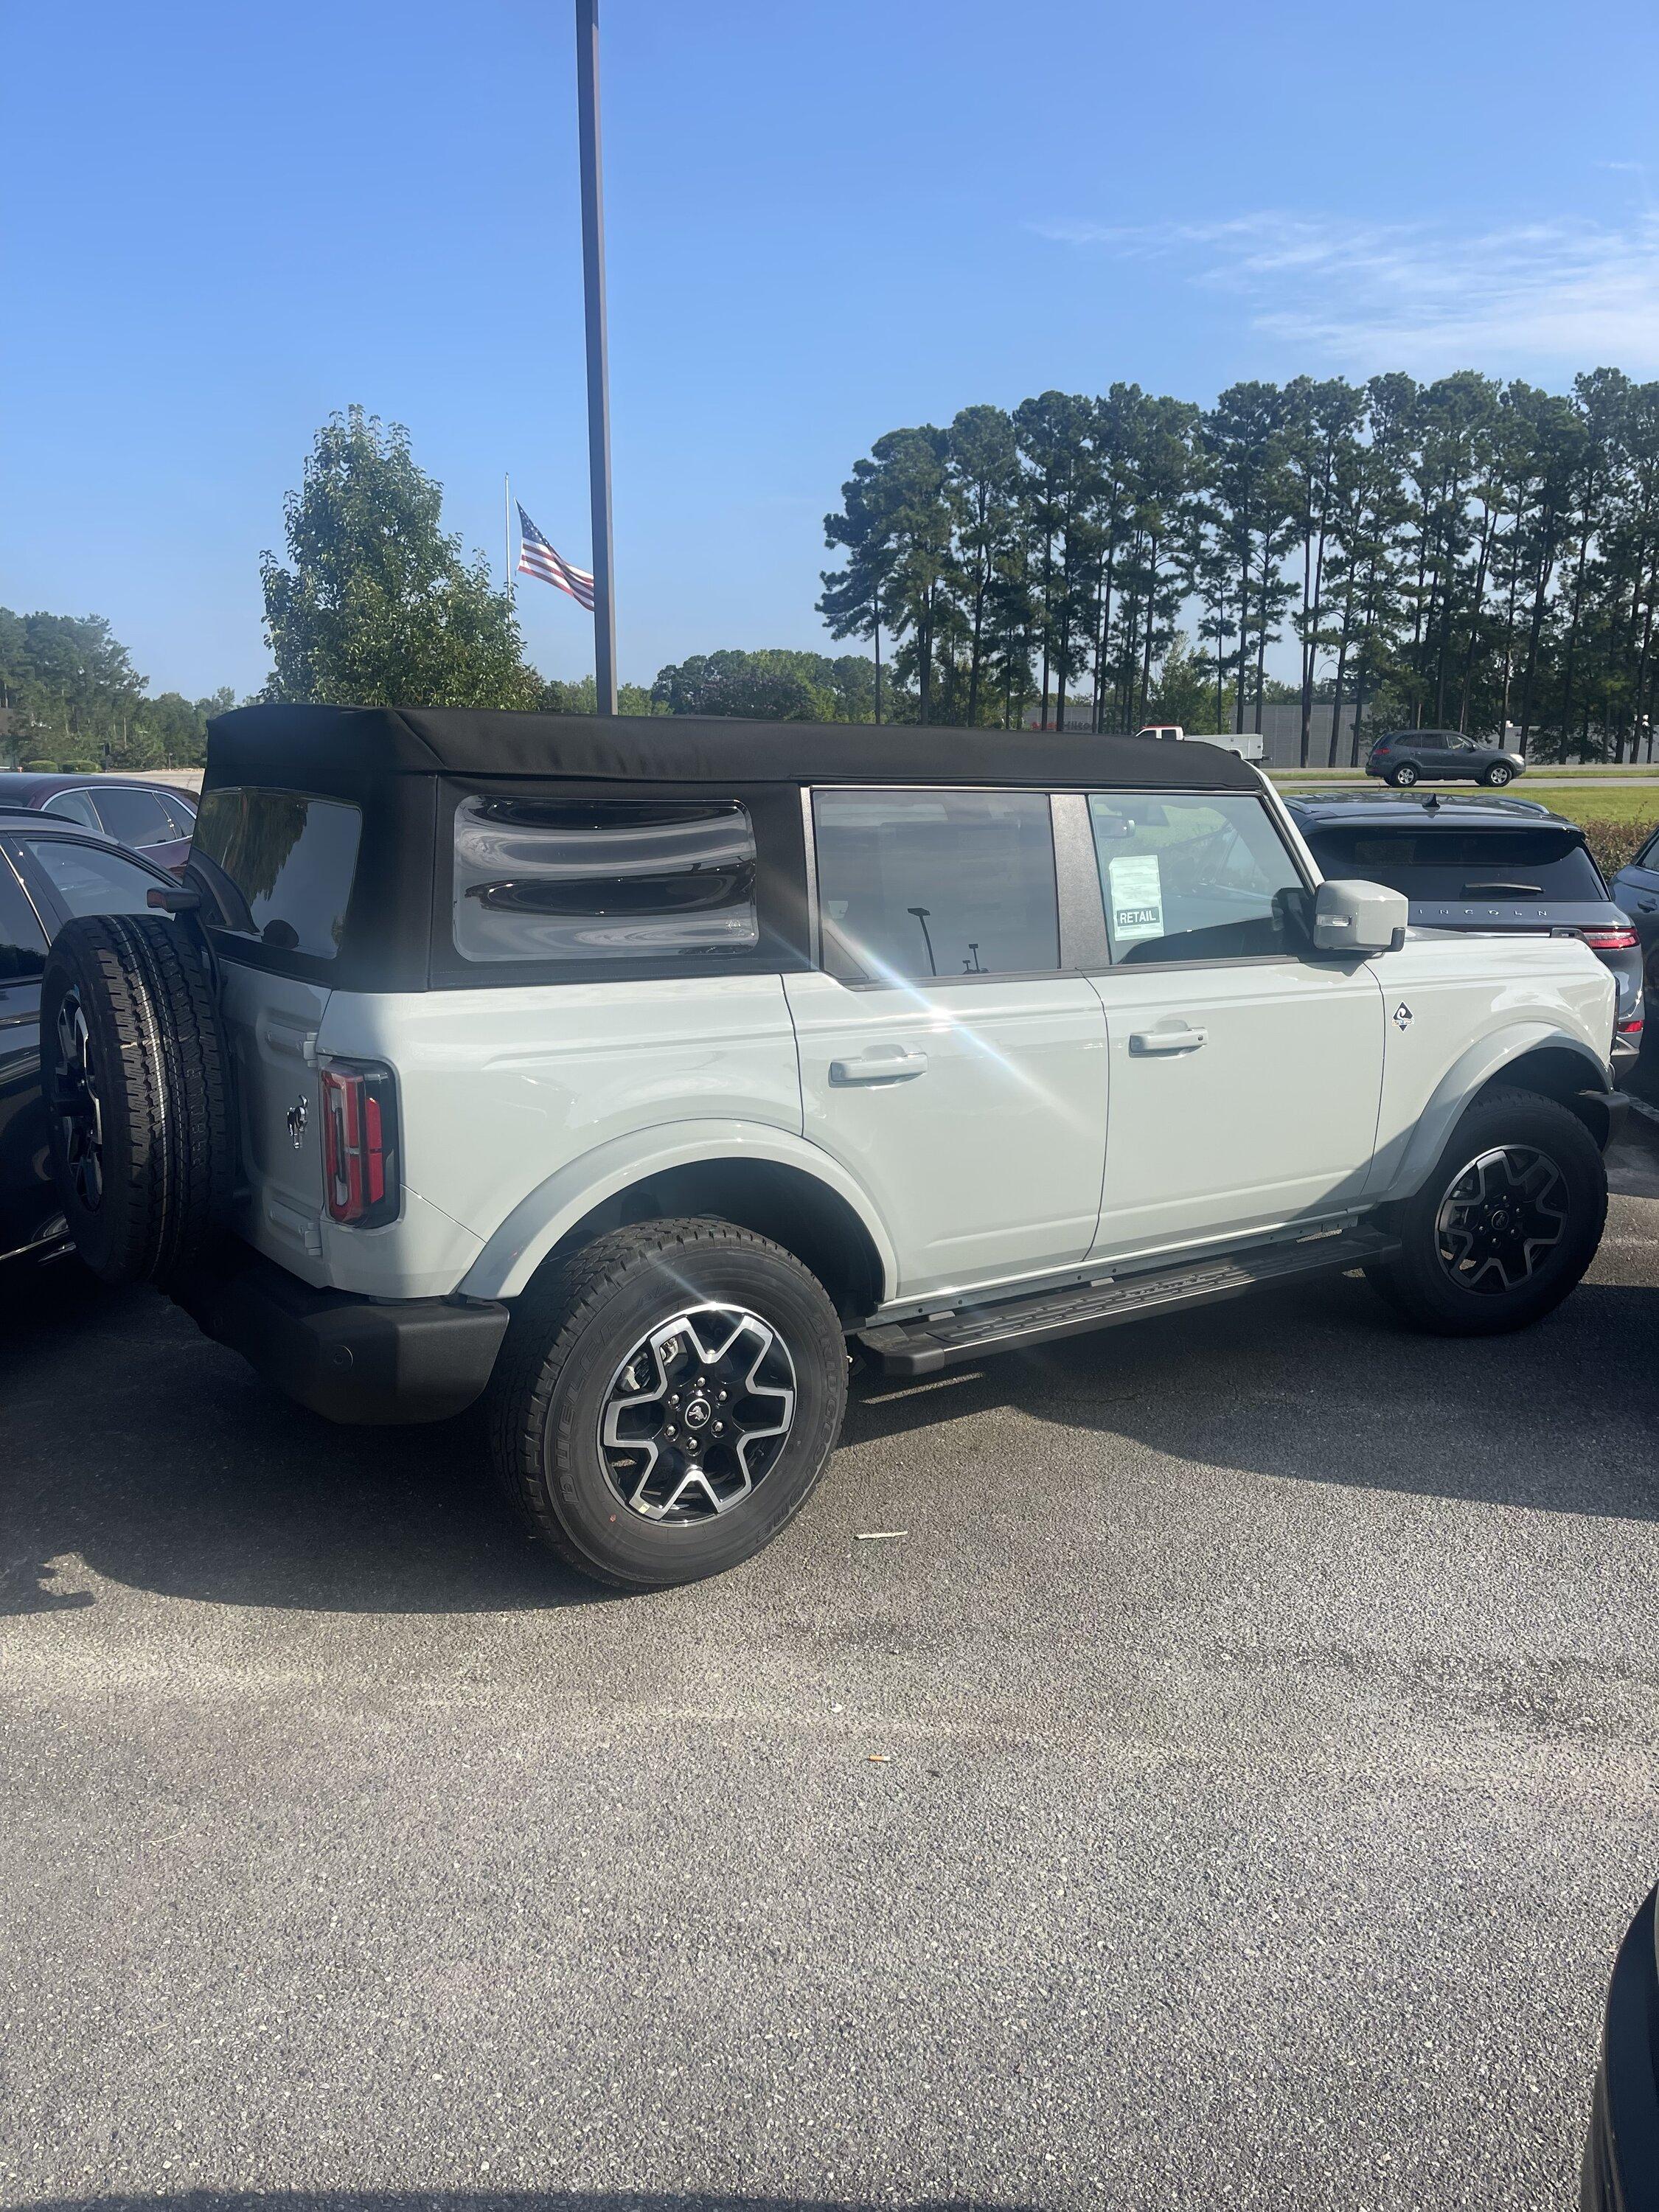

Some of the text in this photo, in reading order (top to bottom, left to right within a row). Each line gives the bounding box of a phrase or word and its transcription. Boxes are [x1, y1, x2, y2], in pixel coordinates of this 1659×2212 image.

[1119, 911, 1157, 924] RETAIL
[1419, 908, 1547, 917] INCOLN
[554, 1309, 626, 1505] DUELER
